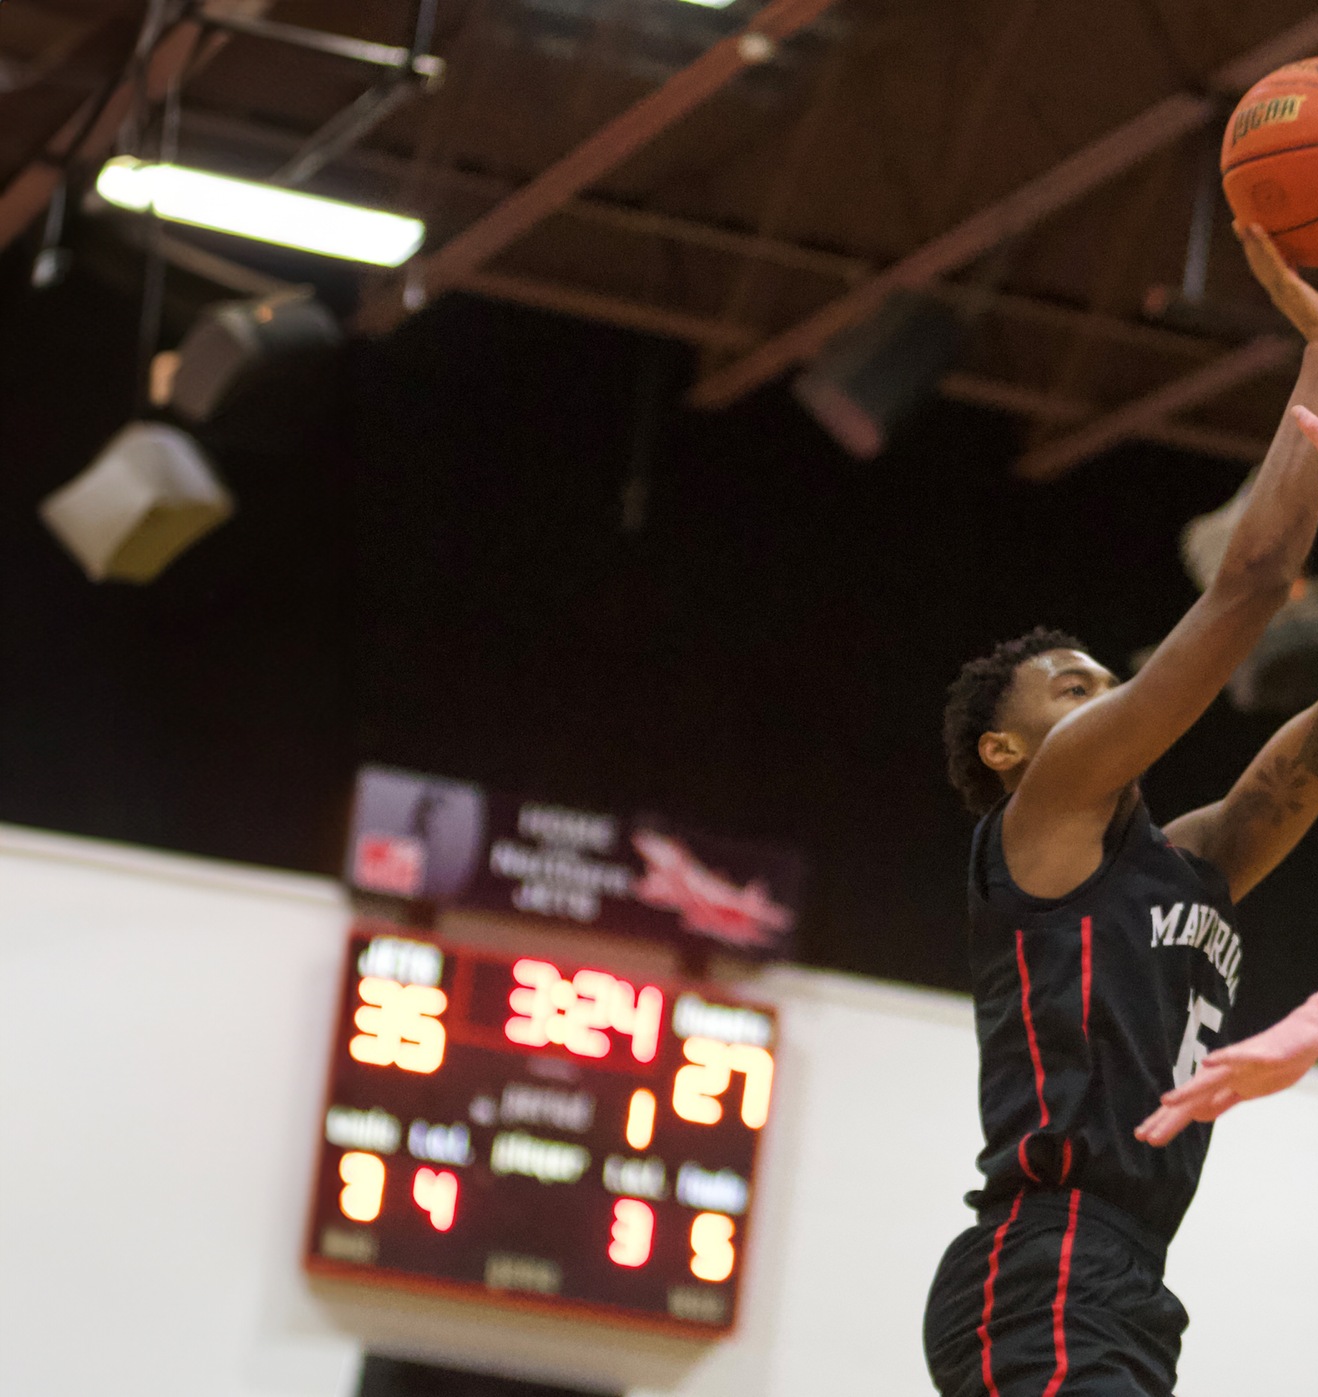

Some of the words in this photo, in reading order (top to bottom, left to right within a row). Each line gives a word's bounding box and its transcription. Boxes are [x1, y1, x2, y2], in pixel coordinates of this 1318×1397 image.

[349, 976, 448, 1074] 35
[505, 958, 663, 1063] 3:24
[672, 1036, 774, 1129] 27
[412, 1166, 459, 1232] 4
[607, 1197, 656, 1268] 3
[689, 1211, 736, 1282] 5
